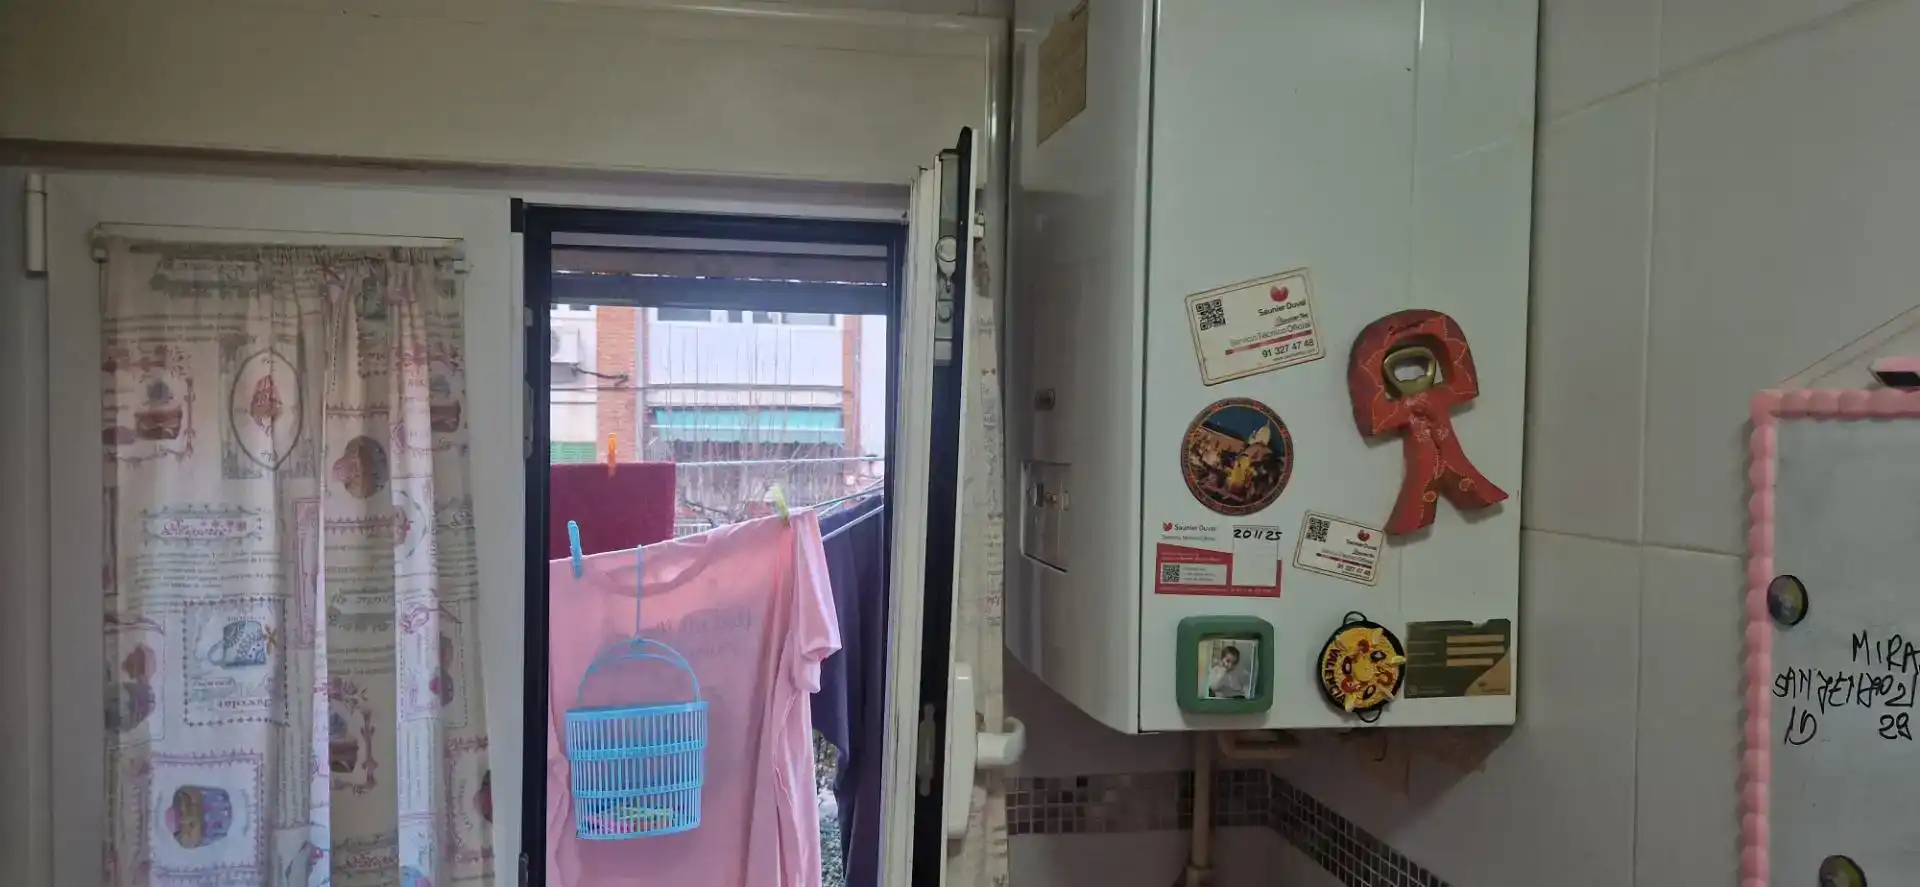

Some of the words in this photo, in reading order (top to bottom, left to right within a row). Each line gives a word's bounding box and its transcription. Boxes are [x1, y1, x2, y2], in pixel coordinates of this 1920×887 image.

[1257, 304, 1285, 316] Saunier
[1286, 299, 1306, 310] Duval
[1261, 348, 1272, 358] 91
[1274, 345, 1289, 356] 327
[1291, 342, 1302, 352] 47
[1303, 338, 1315, 348] 48
[1233, 528, 1252, 540] 20
[1265, 530, 1283, 541] 25
[1772, 666, 1812, 700] SAN
